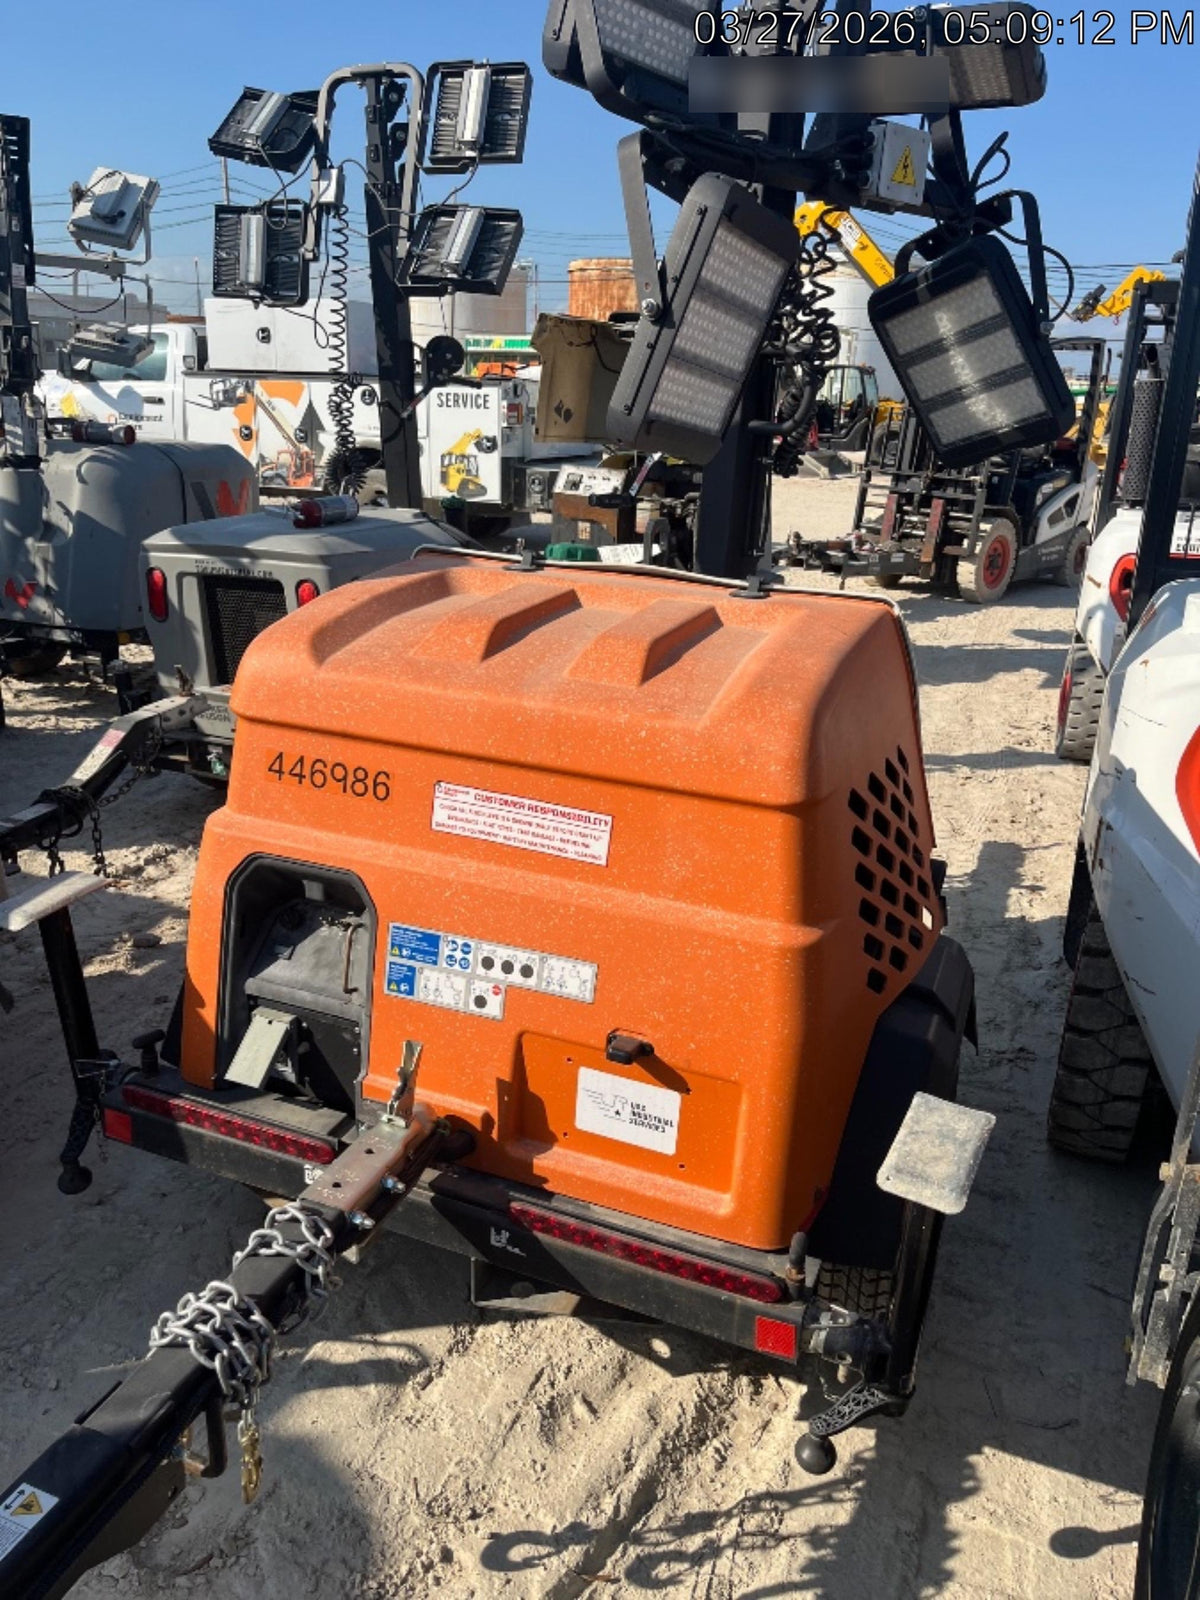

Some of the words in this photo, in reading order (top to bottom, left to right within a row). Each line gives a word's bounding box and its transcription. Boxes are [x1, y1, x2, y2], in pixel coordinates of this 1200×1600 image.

[436, 392, 490, 410] SERVICE
[267, 751, 390, 801] 446986
[474, 793, 526, 811] CUSTOMER
